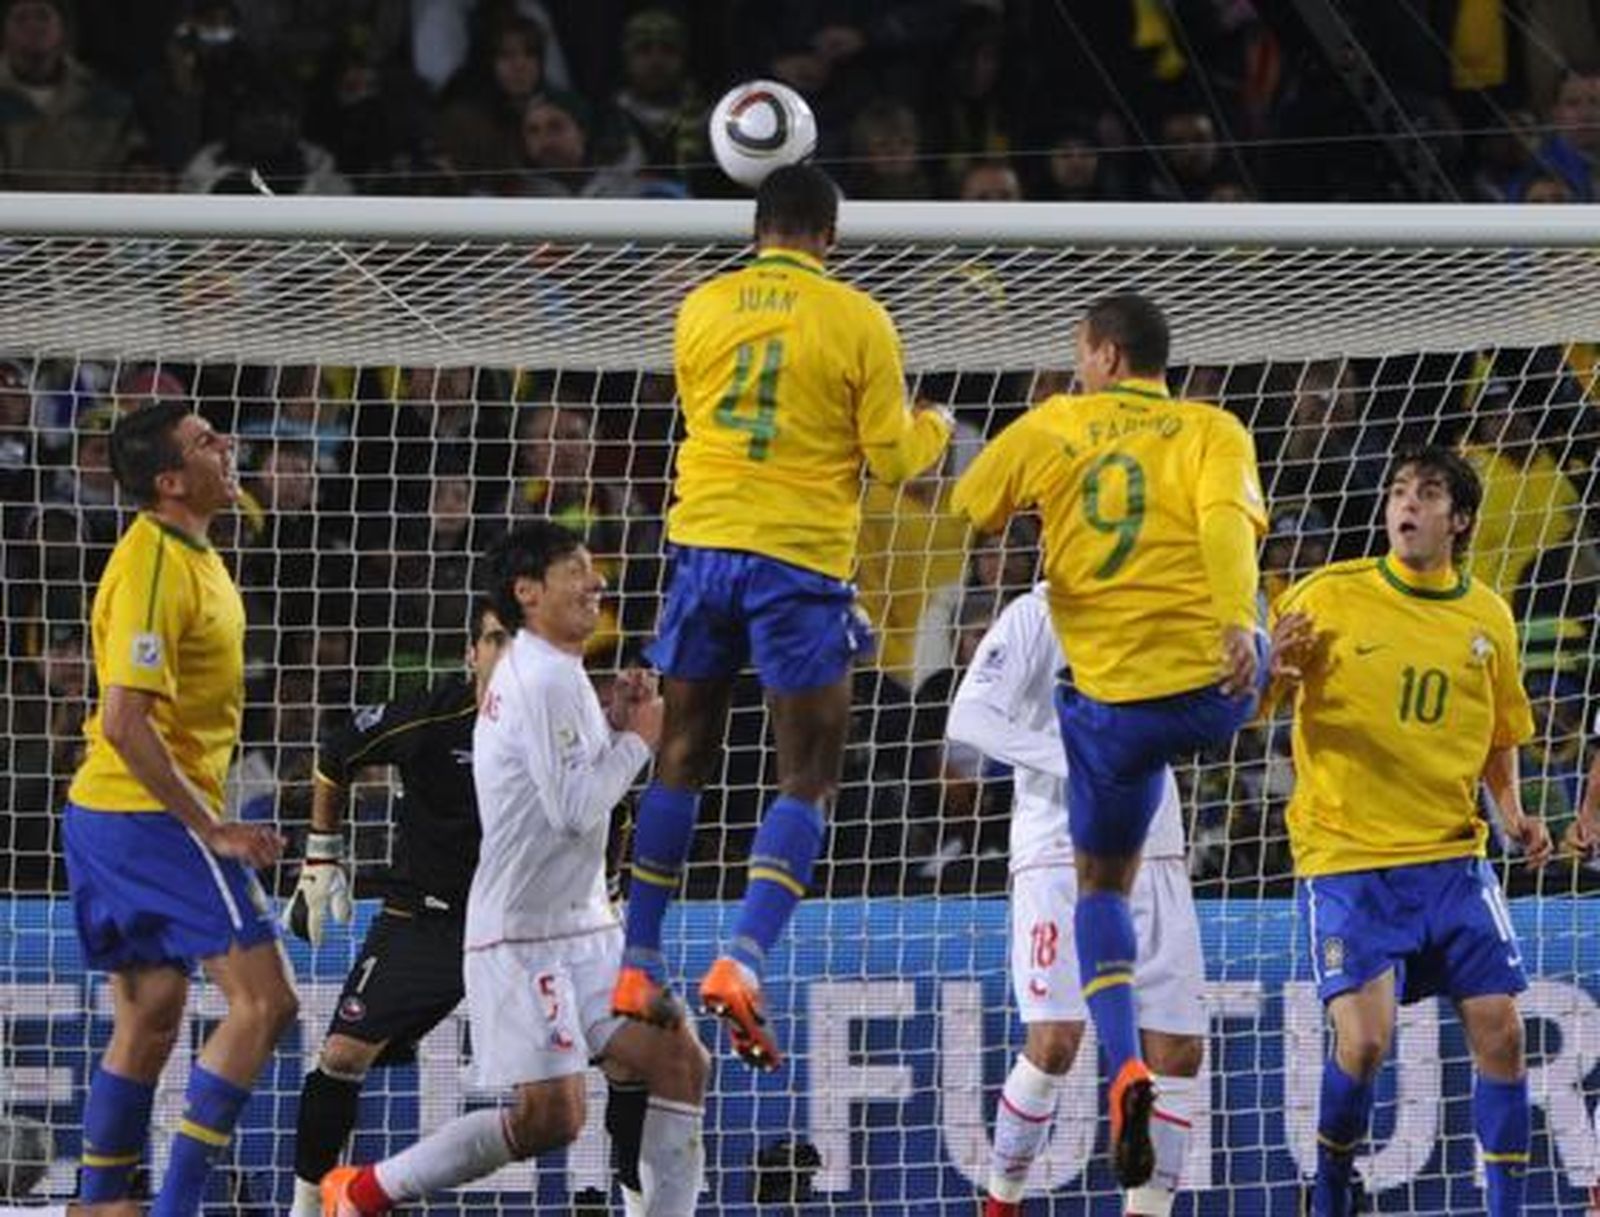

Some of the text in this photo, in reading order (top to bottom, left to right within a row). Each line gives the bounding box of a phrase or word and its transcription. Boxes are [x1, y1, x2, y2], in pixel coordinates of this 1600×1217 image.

[735, 284, 799, 313] JUAN
[713, 338, 783, 461] 4
[1082, 453, 1145, 581] 9
[1401, 665, 1449, 725] 10
[1030, 921, 1058, 969] 18
[356, 956, 377, 994] 1
